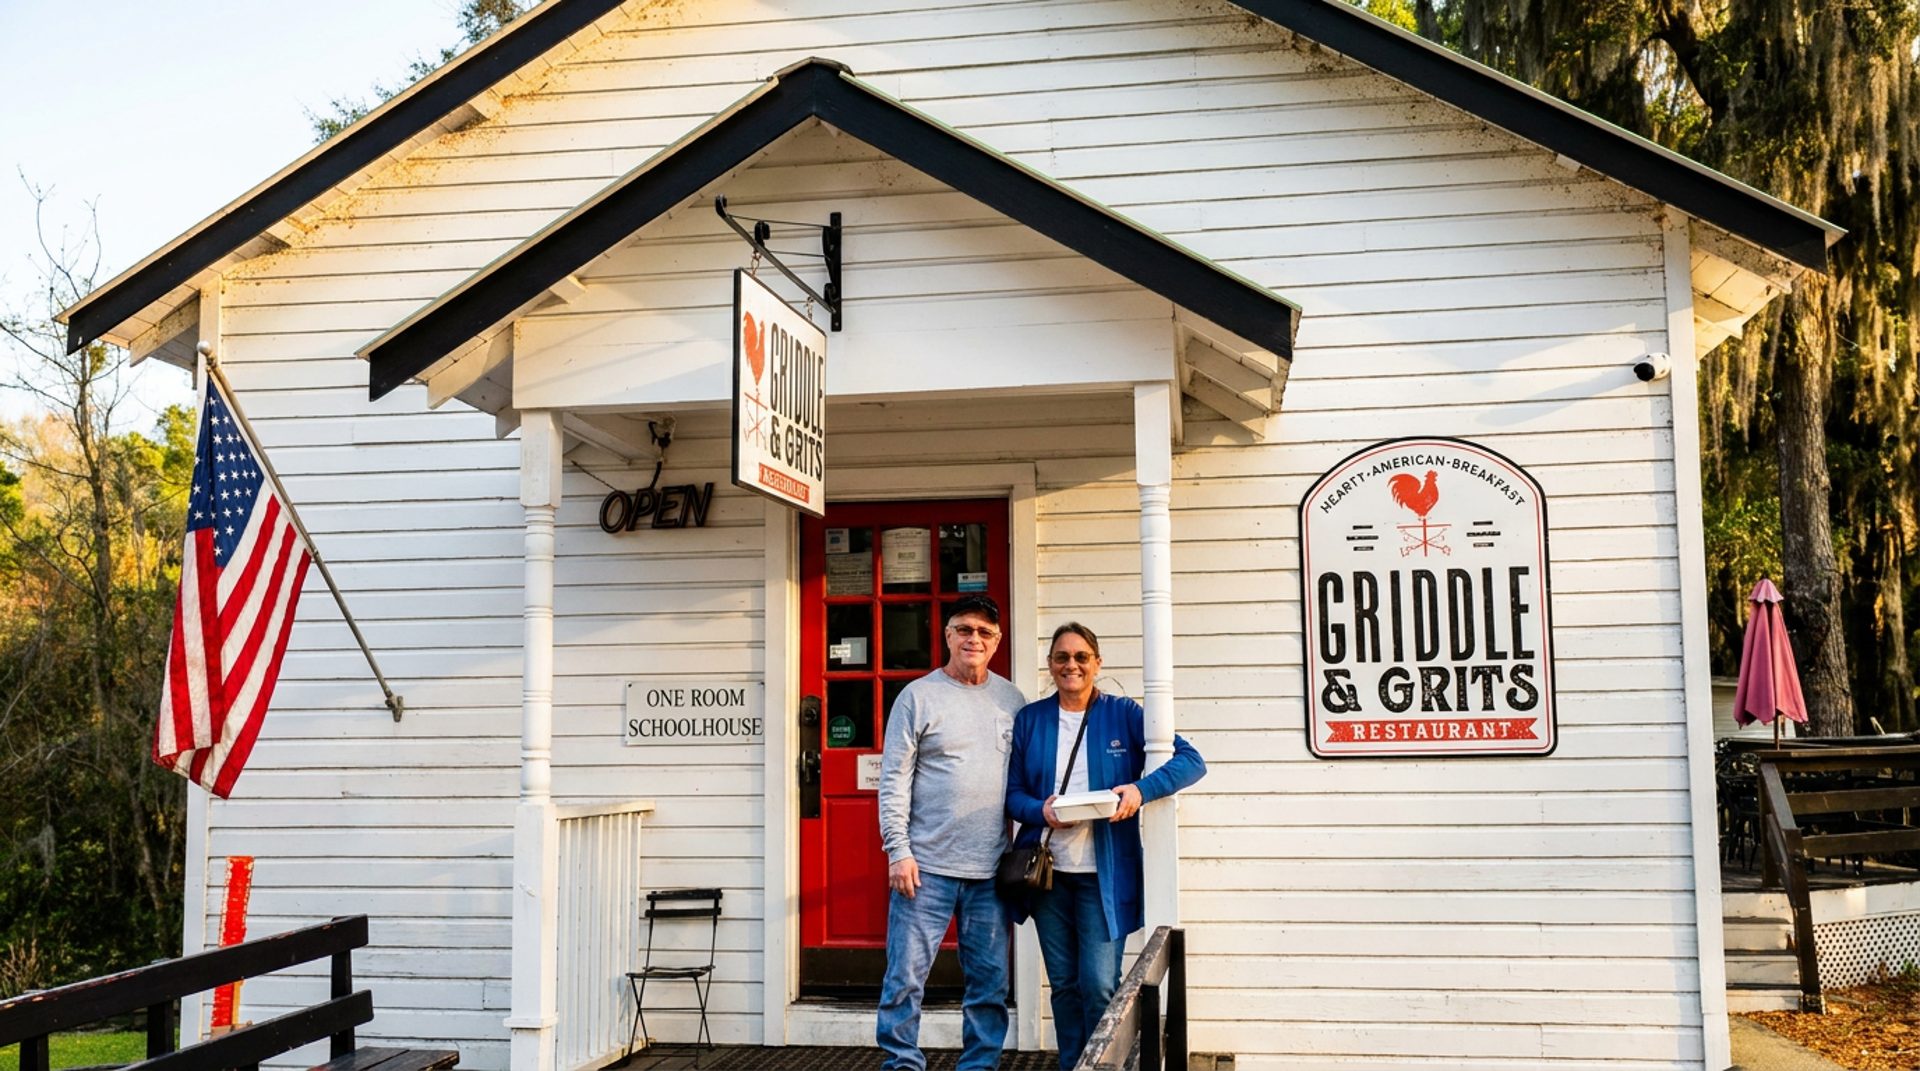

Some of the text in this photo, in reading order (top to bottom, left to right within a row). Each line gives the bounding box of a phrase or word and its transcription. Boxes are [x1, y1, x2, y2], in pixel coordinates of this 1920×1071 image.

[770, 322, 823, 439] GRIDDLE
[770, 415, 823, 482] & GRITS
[599, 482, 714, 534] OPEN
[1318, 566, 1535, 664] GRIDDLE
[646, 688, 745, 707] ONE ROOM
[1321, 664, 1539, 713] & GRITS
[628, 717, 764, 737] SCHOOLHOUSE
[1350, 721, 1512, 740] RESTAURANT
